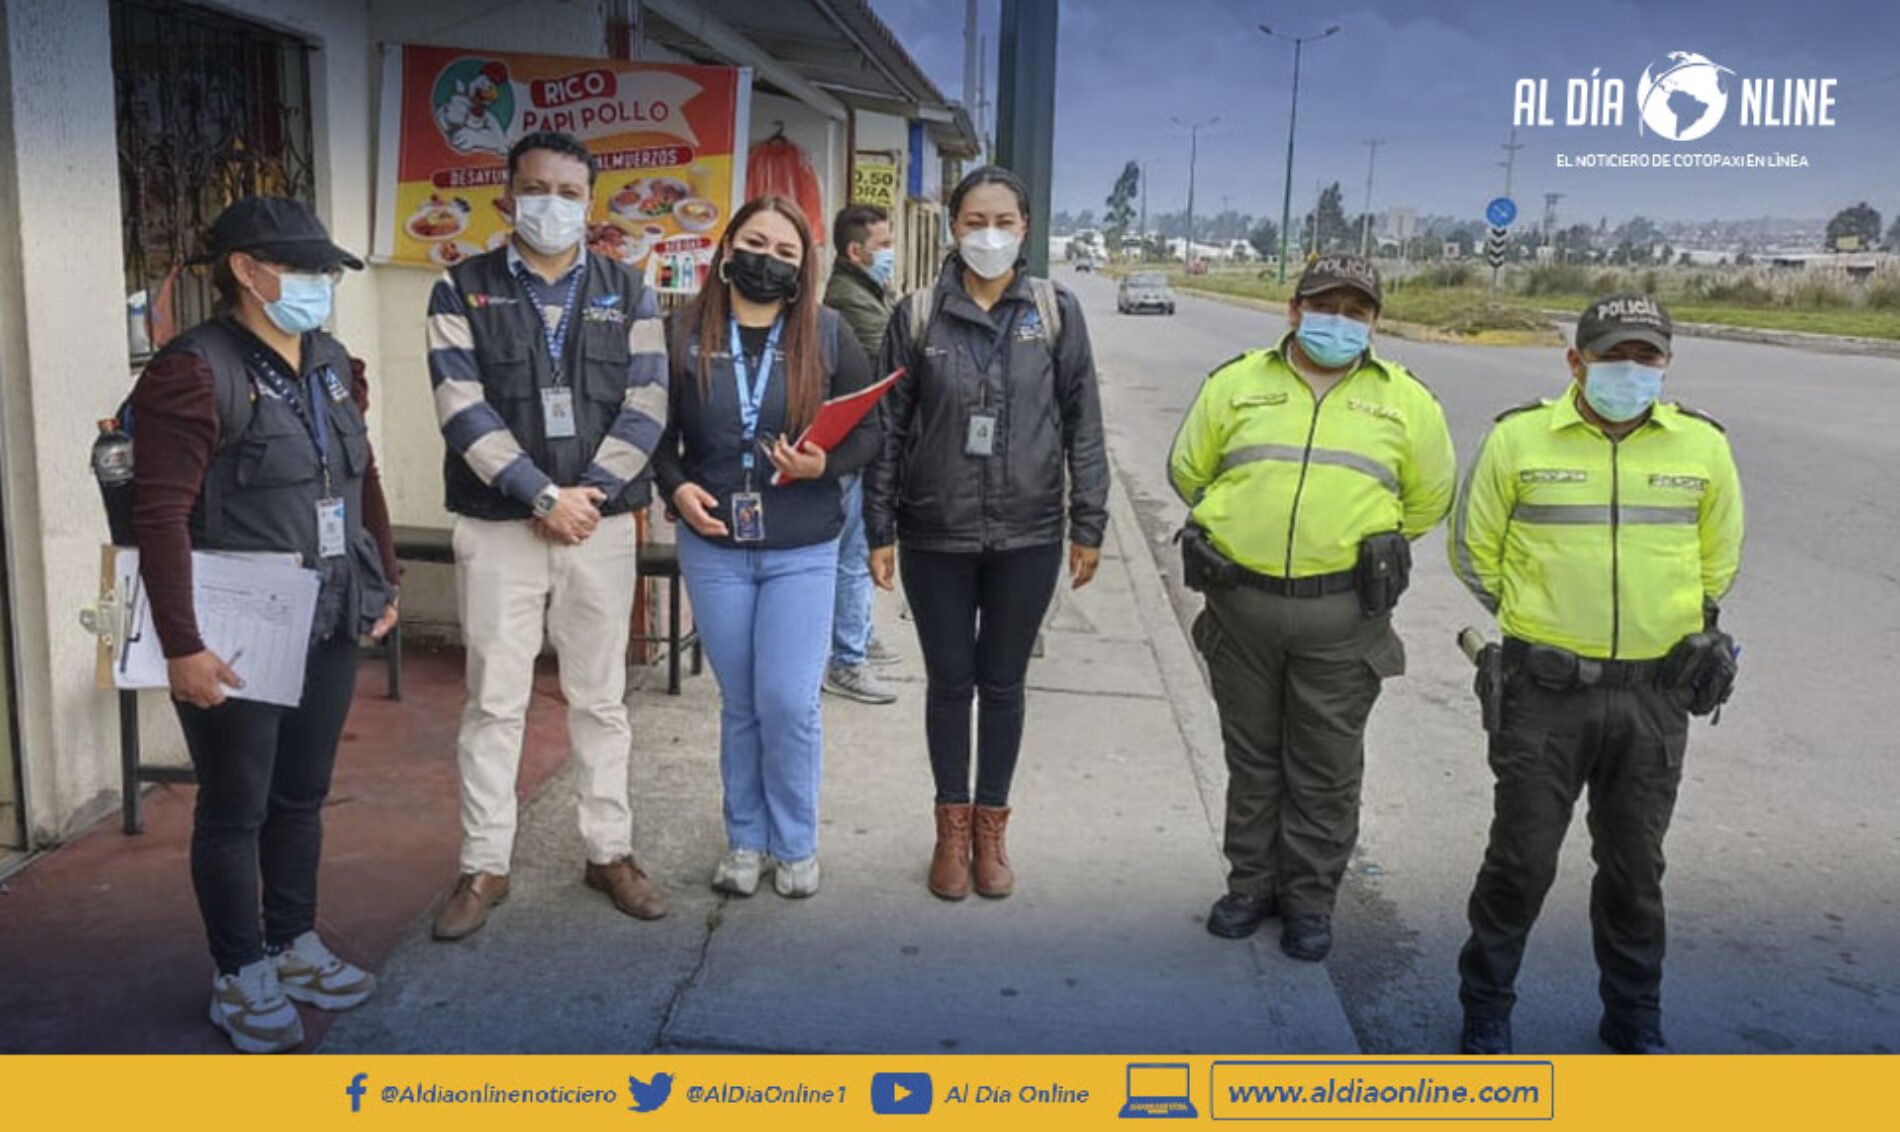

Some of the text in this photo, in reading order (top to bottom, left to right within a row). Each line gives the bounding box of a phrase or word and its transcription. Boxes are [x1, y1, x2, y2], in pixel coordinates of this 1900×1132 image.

[545, 72, 606, 105] RICO
[522, 101, 669, 133] PAPI POLLO
